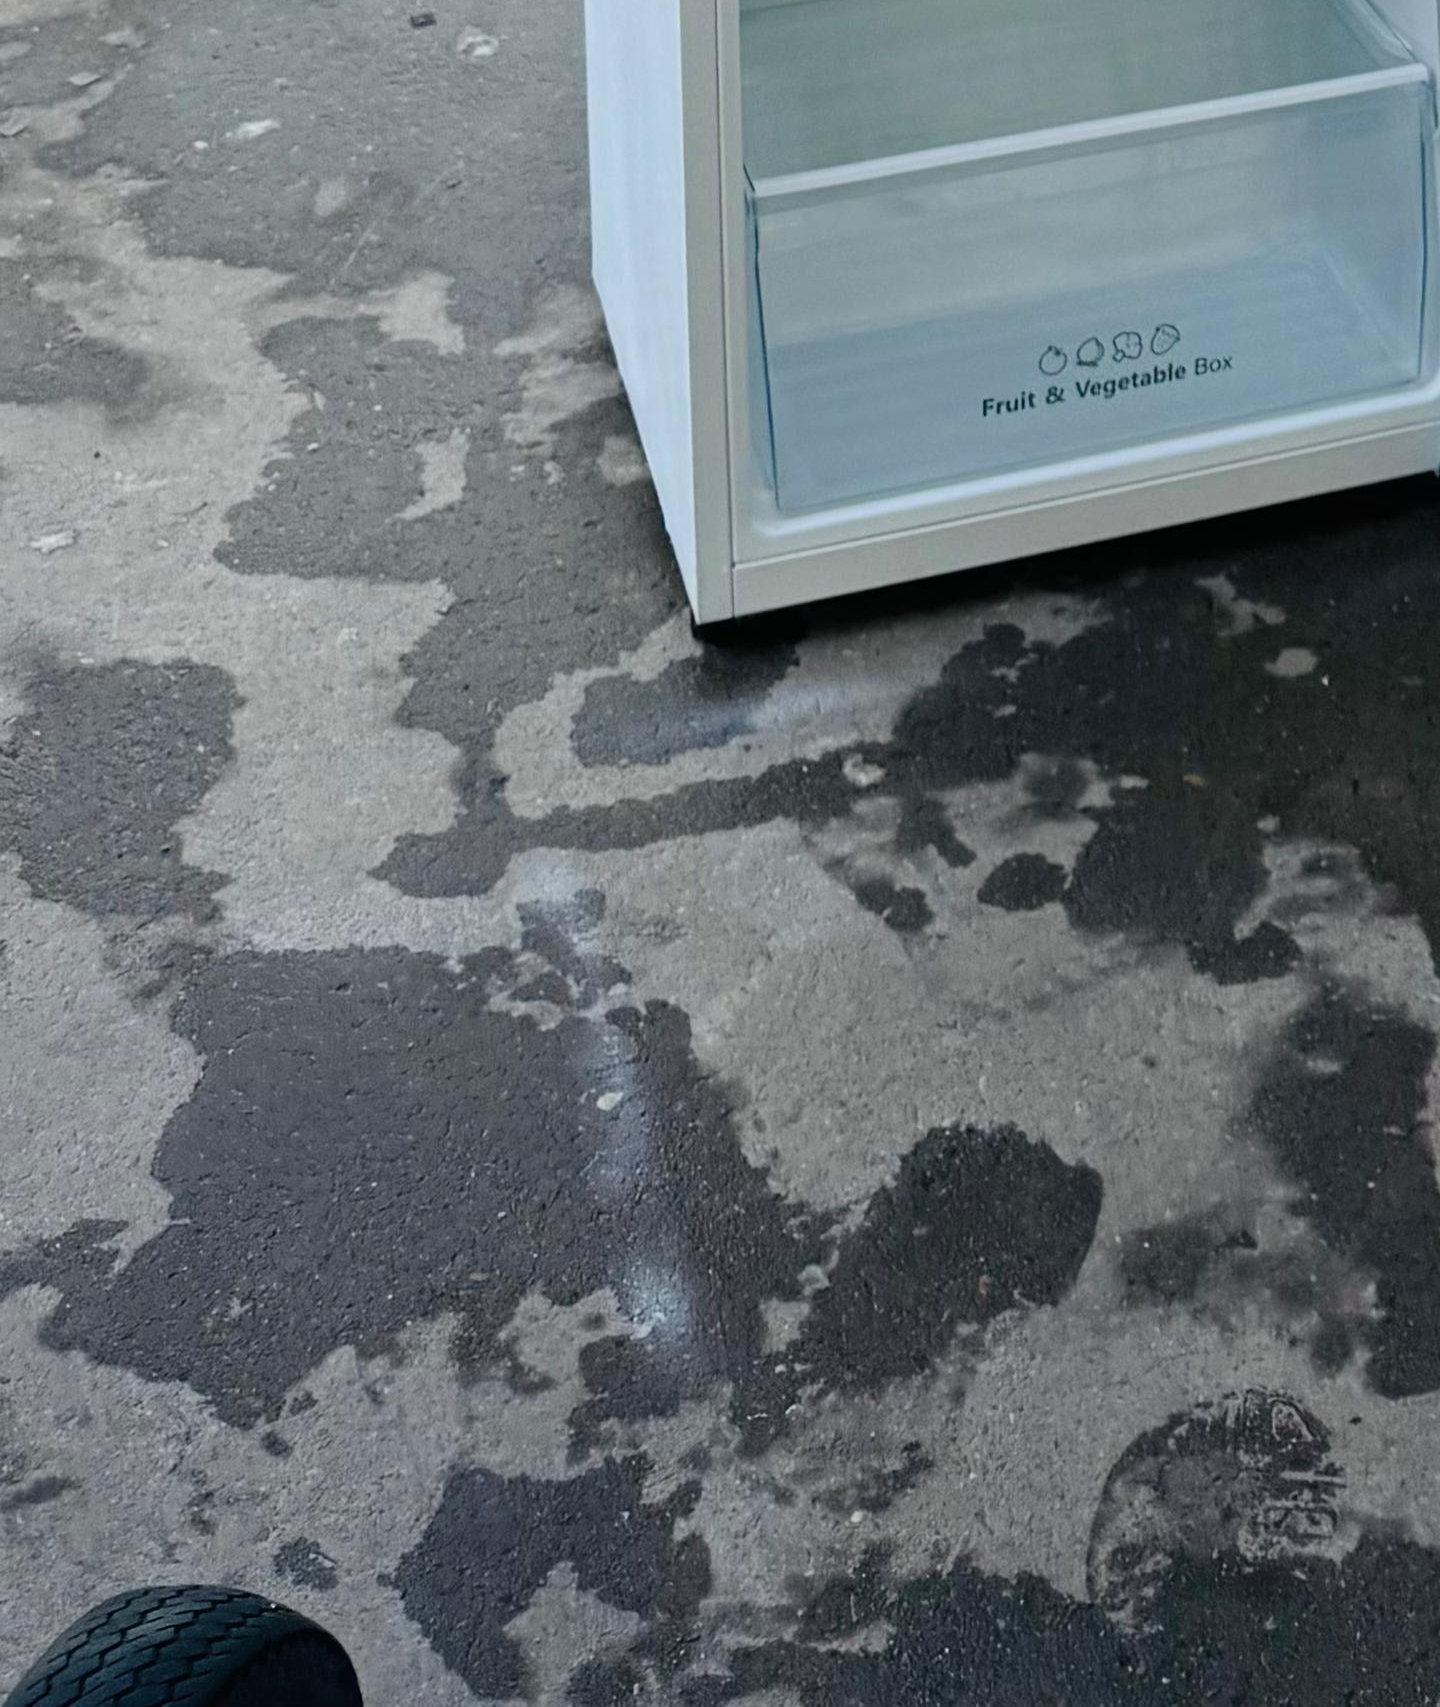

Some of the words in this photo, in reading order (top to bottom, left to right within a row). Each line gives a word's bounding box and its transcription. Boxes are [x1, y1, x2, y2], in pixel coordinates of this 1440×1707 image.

[982, 391, 1036, 417] Fruit
[1045, 385, 1065, 405] &
[1075, 363, 1187, 399] Vegetable
[1194, 355, 1233, 376] Box
